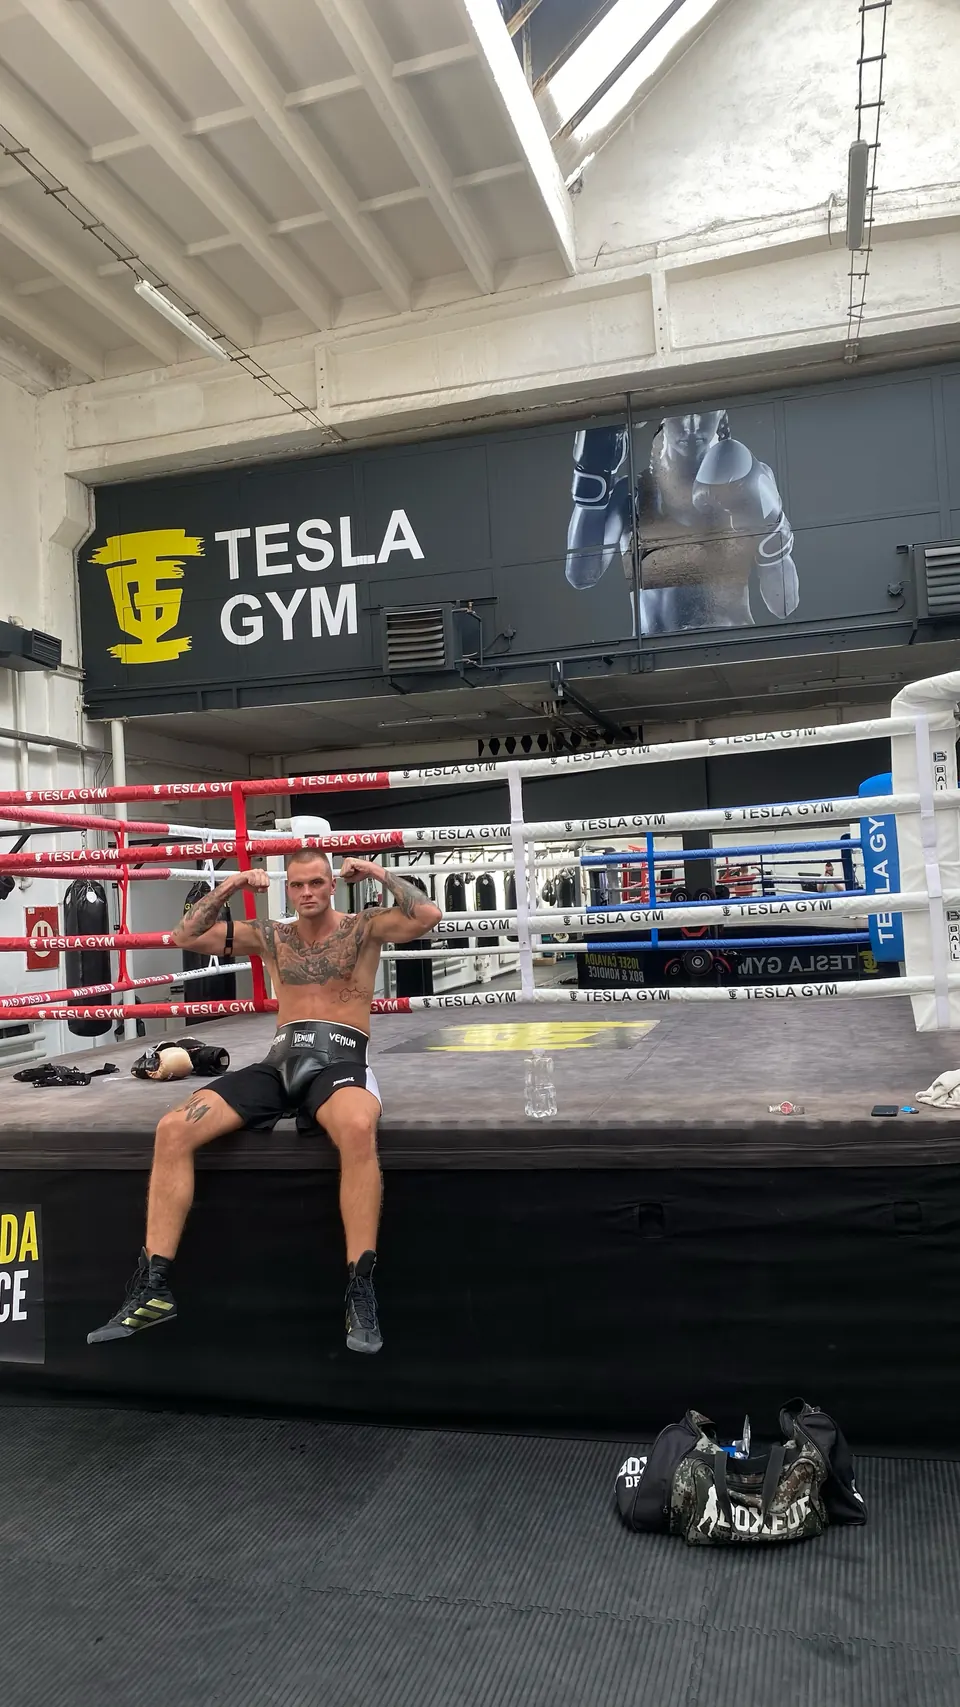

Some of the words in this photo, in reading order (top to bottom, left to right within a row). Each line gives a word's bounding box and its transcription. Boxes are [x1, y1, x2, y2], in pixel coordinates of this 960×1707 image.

[214, 509, 425, 580] TESLA
[220, 583, 359, 646] GYM
[725, 730, 775, 745] TESLA
[780, 727, 817, 740] GYM
[565, 749, 611, 764] TESLA
[616, 745, 651, 756] GYM
[417, 766, 461, 778] TESLA
[465, 762, 497, 773] GYM
[301, 774, 343, 786] TESLA
[347, 772, 378, 783] GYM
[38, 789, 76, 801] TESLA
[79, 787, 108, 799] GYM
[166, 782, 206, 794] TESLA
[740, 805, 792, 820] TESLA
[797, 802, 834, 816] GYM
[580, 818, 627, 832] TESLA
[632, 814, 666, 828] GYM
[314, 835, 356, 848] TESLA
[360, 832, 391, 844] GYM
[430, 827, 474, 840] TESLA
[479, 825, 512, 838] GYM
[868, 816, 888, 853] GY
[47, 851, 87, 863] TESLA
[90, 849, 119, 860] GYM
[179, 843, 220, 855] TESLA
[223, 841, 253, 853] GM
[737, 902, 790, 916] TESLA
[794, 899, 832, 912] GYM
[873, 859, 894, 944] TELA
[430, 920, 474, 933] TESLA
[478, 918, 510, 931] GYM
[577, 913, 625, 926] TESLA
[630, 910, 664, 923] GYM
[42, 937, 83, 949] TESLA
[86, 936, 115, 948] GYM
[436, 995, 481, 1008] TESLA
[484, 992, 516, 1004] GYM
[584, 990, 632, 1002] TESLA
[637, 989, 671, 1001] GYM
[744, 986, 796, 1000] TESLA
[801, 984, 838, 997] GYM
[51, 1009, 91, 1019] TESLA
[95, 1008, 125, 1018] GYM
[183, 1003, 227, 1015] TESLA
[370, 1000, 398, 1012] GYM
[294, 1032, 315, 1044] VENUM
[329, 1032, 356, 1048] VENUM
[0, 1211, 39, 1264] DA
